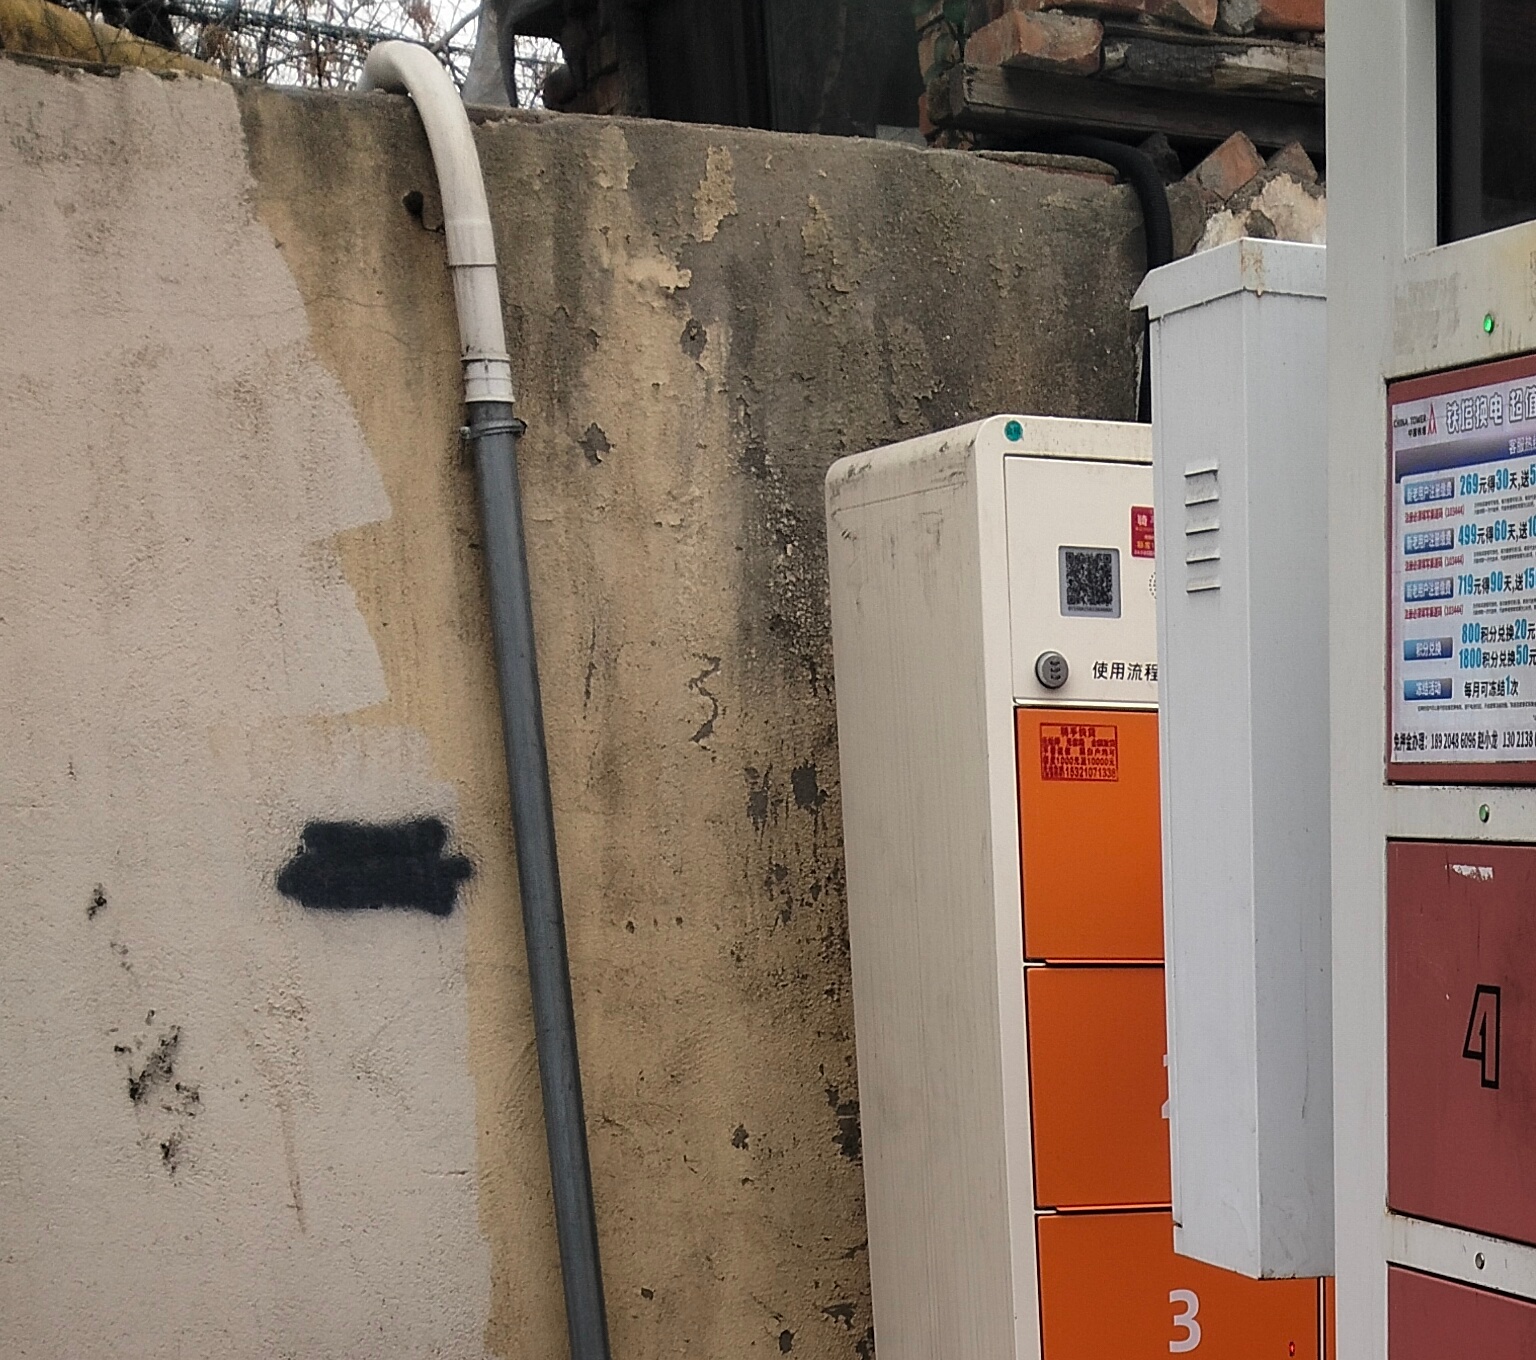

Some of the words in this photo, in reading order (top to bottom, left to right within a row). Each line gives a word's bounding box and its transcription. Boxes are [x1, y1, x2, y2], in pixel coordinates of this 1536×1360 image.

[1445, 393, 1503, 434] 铁塔换电
[1092, 660, 1159, 682] 使用流程
[1463, 984, 1500, 1090] 4
[1169, 1289, 1201, 1353] 3
